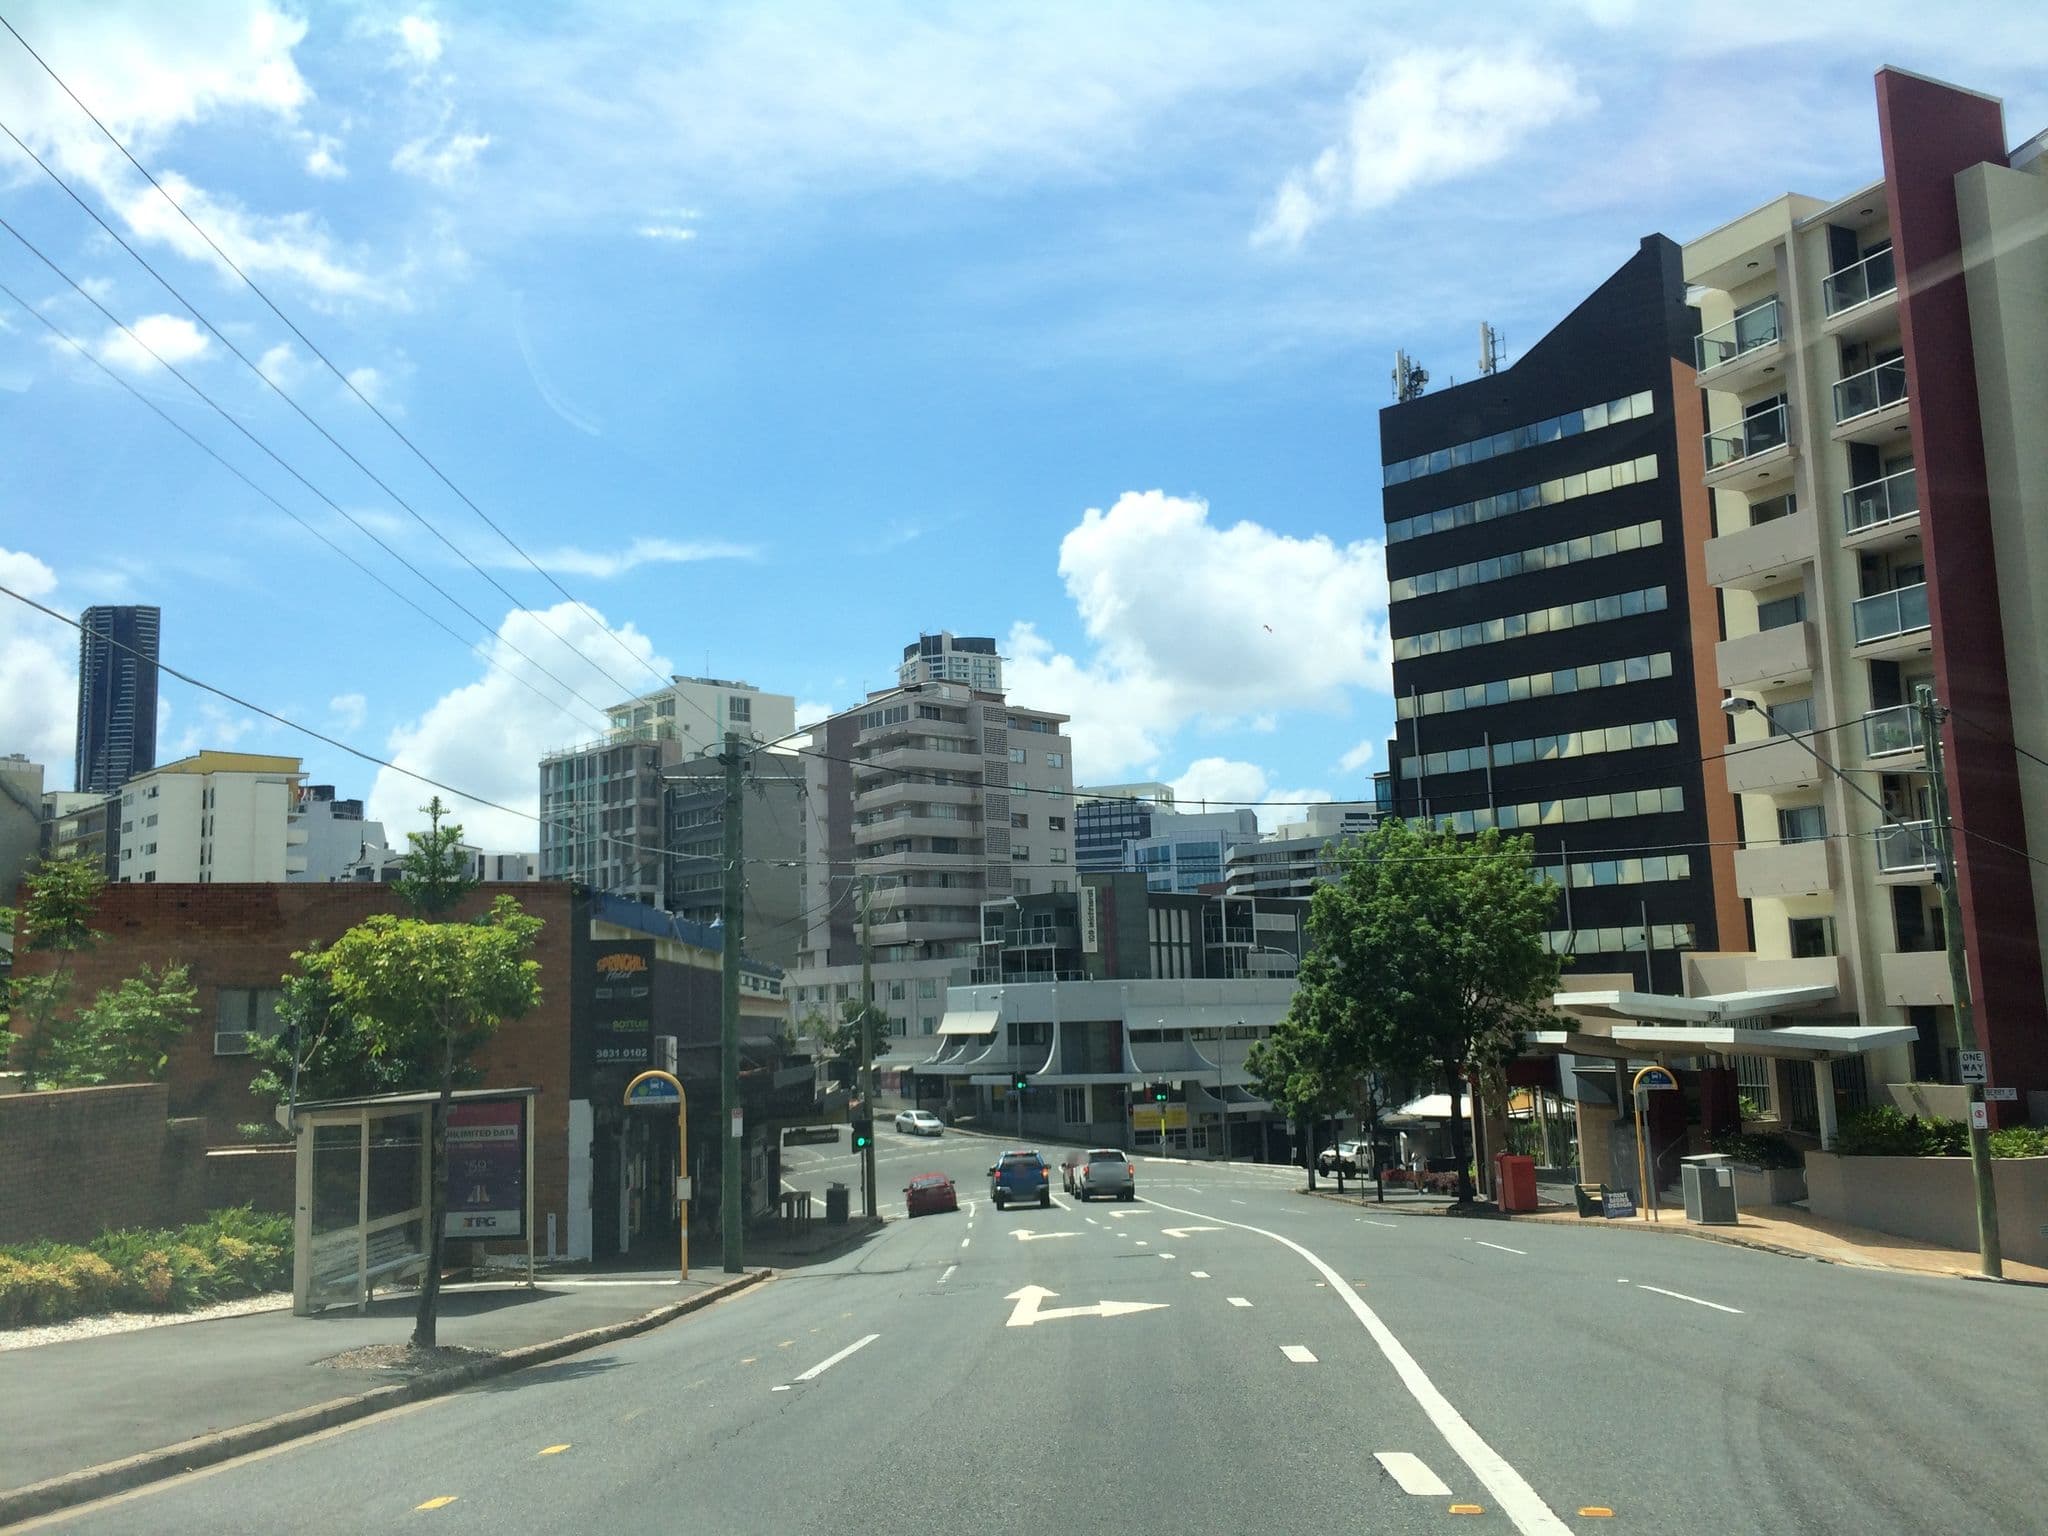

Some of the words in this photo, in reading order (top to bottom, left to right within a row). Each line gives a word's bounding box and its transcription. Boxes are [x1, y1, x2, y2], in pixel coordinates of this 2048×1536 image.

[623, 1048, 648, 1057] 0102
[1962, 1053, 1982, 1061] ONE
[1962, 1063, 1984, 1072] WAY
[493, 1128, 515, 1137] DATA
[463, 1216, 496, 1227] TPG
